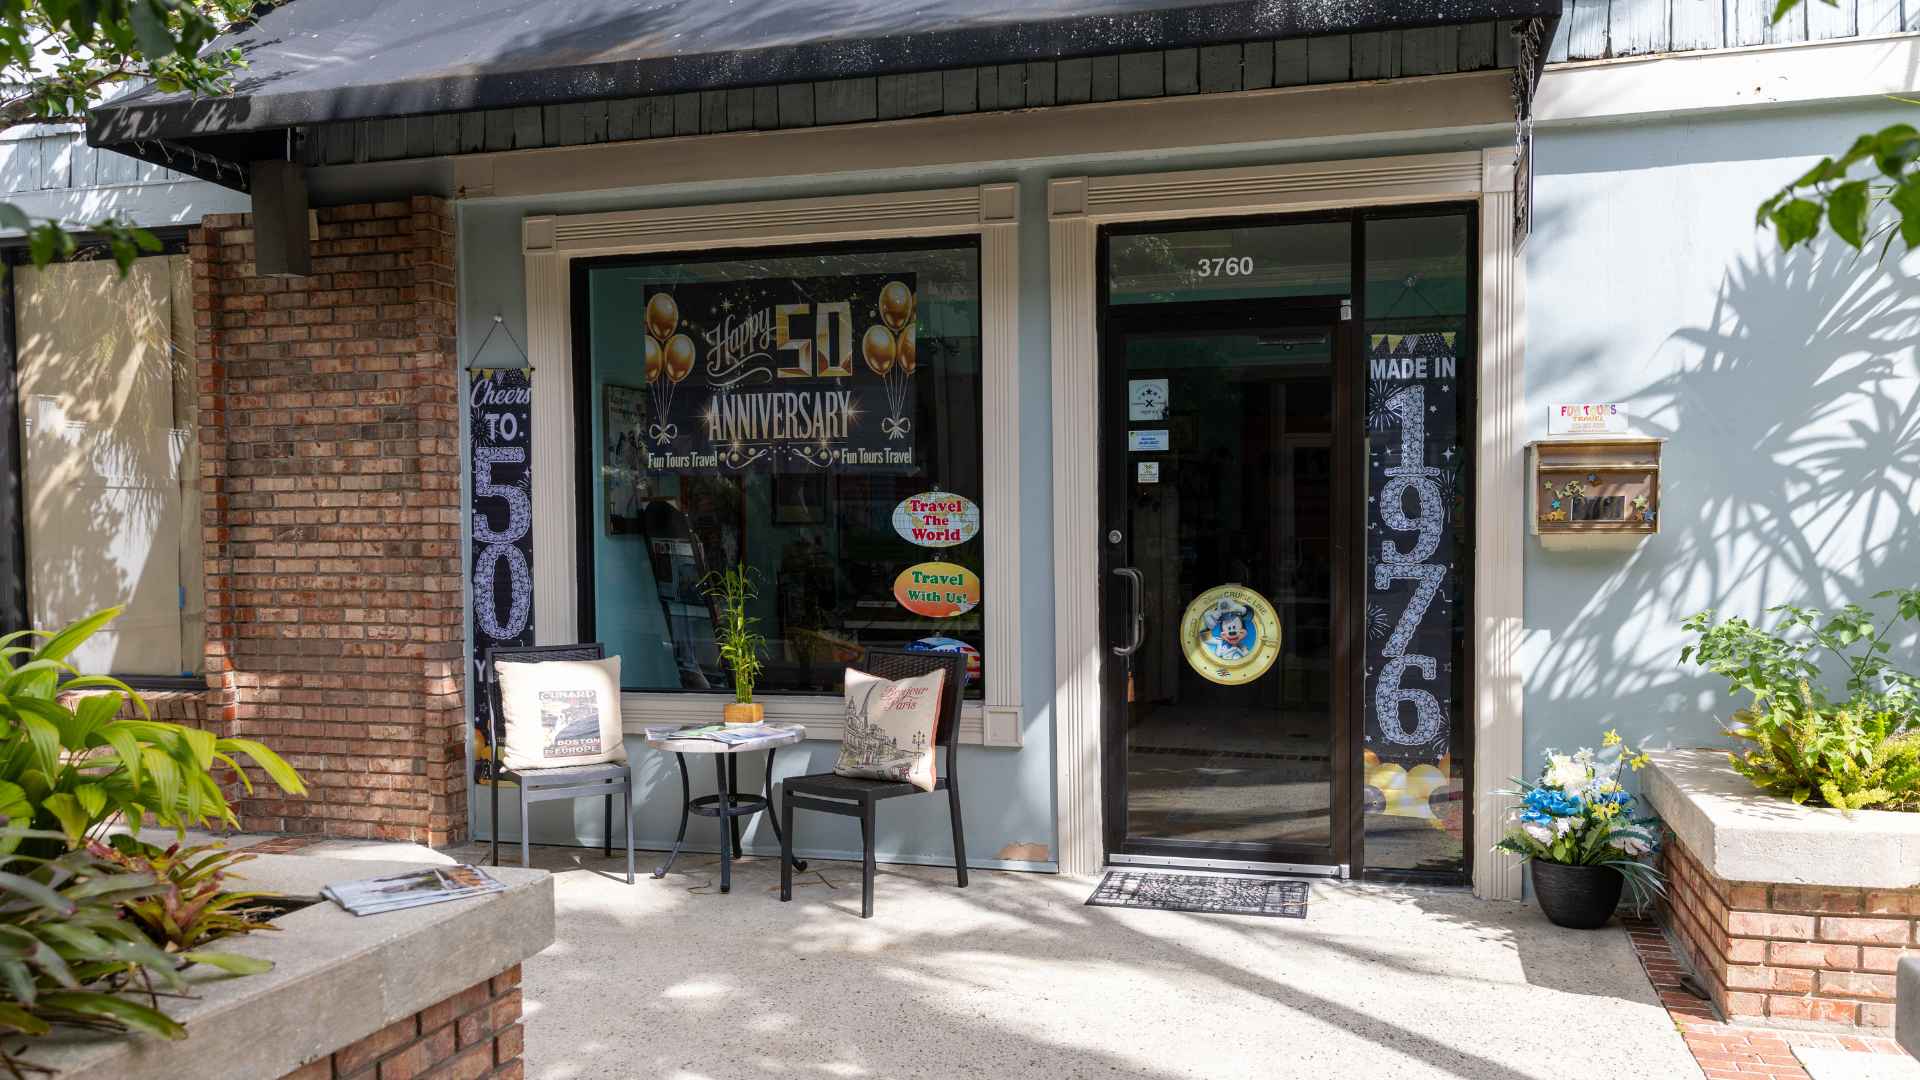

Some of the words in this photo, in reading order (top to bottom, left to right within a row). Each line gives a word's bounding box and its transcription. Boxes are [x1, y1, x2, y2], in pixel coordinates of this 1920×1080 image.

[1198, 257, 1254, 277] 3760
[706, 307, 776, 372] Happy
[776, 302, 852, 378] 50
[1370, 357, 1428, 379] MADE
[1434, 357, 1456, 379] IN
[471, 379, 533, 407] Cheers
[708, 390, 851, 441] ANNIVERSARY
[485, 412, 518, 441] TO
[648, 453, 664, 469] Fun
[666, 452, 690, 468] Tours
[691, 451, 718, 467] Travel
[841, 449, 857, 465] Fun
[859, 448, 883, 464] Tours
[885, 447, 912, 464] Travel
[910, 500, 962, 513] Travel
[923, 514, 949, 526] The
[471, 446, 532, 640] 50
[911, 528, 961, 541] World
[1374, 384, 1447, 746] 1976
[912, 571, 964, 586] Travel
[908, 590, 941, 602] With
[946, 592, 968, 604] Us!
[886, 699, 917, 711] Paris
[556, 737, 600, 746] BOSTON
